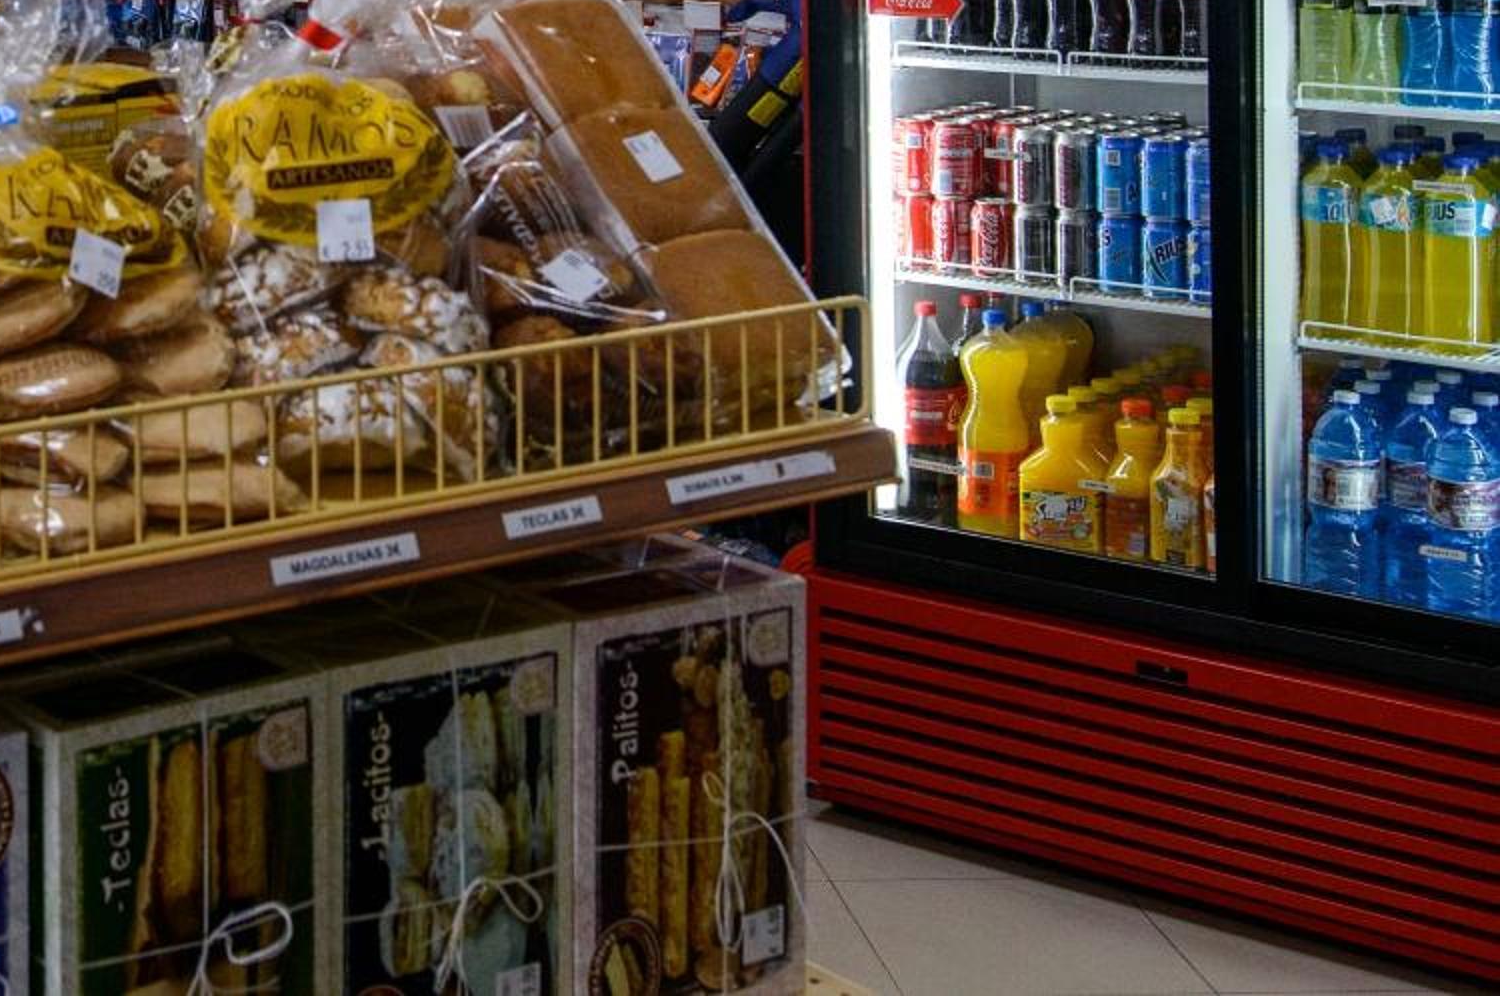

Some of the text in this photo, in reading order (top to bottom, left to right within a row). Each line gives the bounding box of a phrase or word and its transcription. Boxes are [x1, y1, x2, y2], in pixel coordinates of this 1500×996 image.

[270, 160, 392, 187] ARTESANOS
[520, 509, 569, 529] TECLAS
[289, 545, 383, 574] MAGDALENAS
